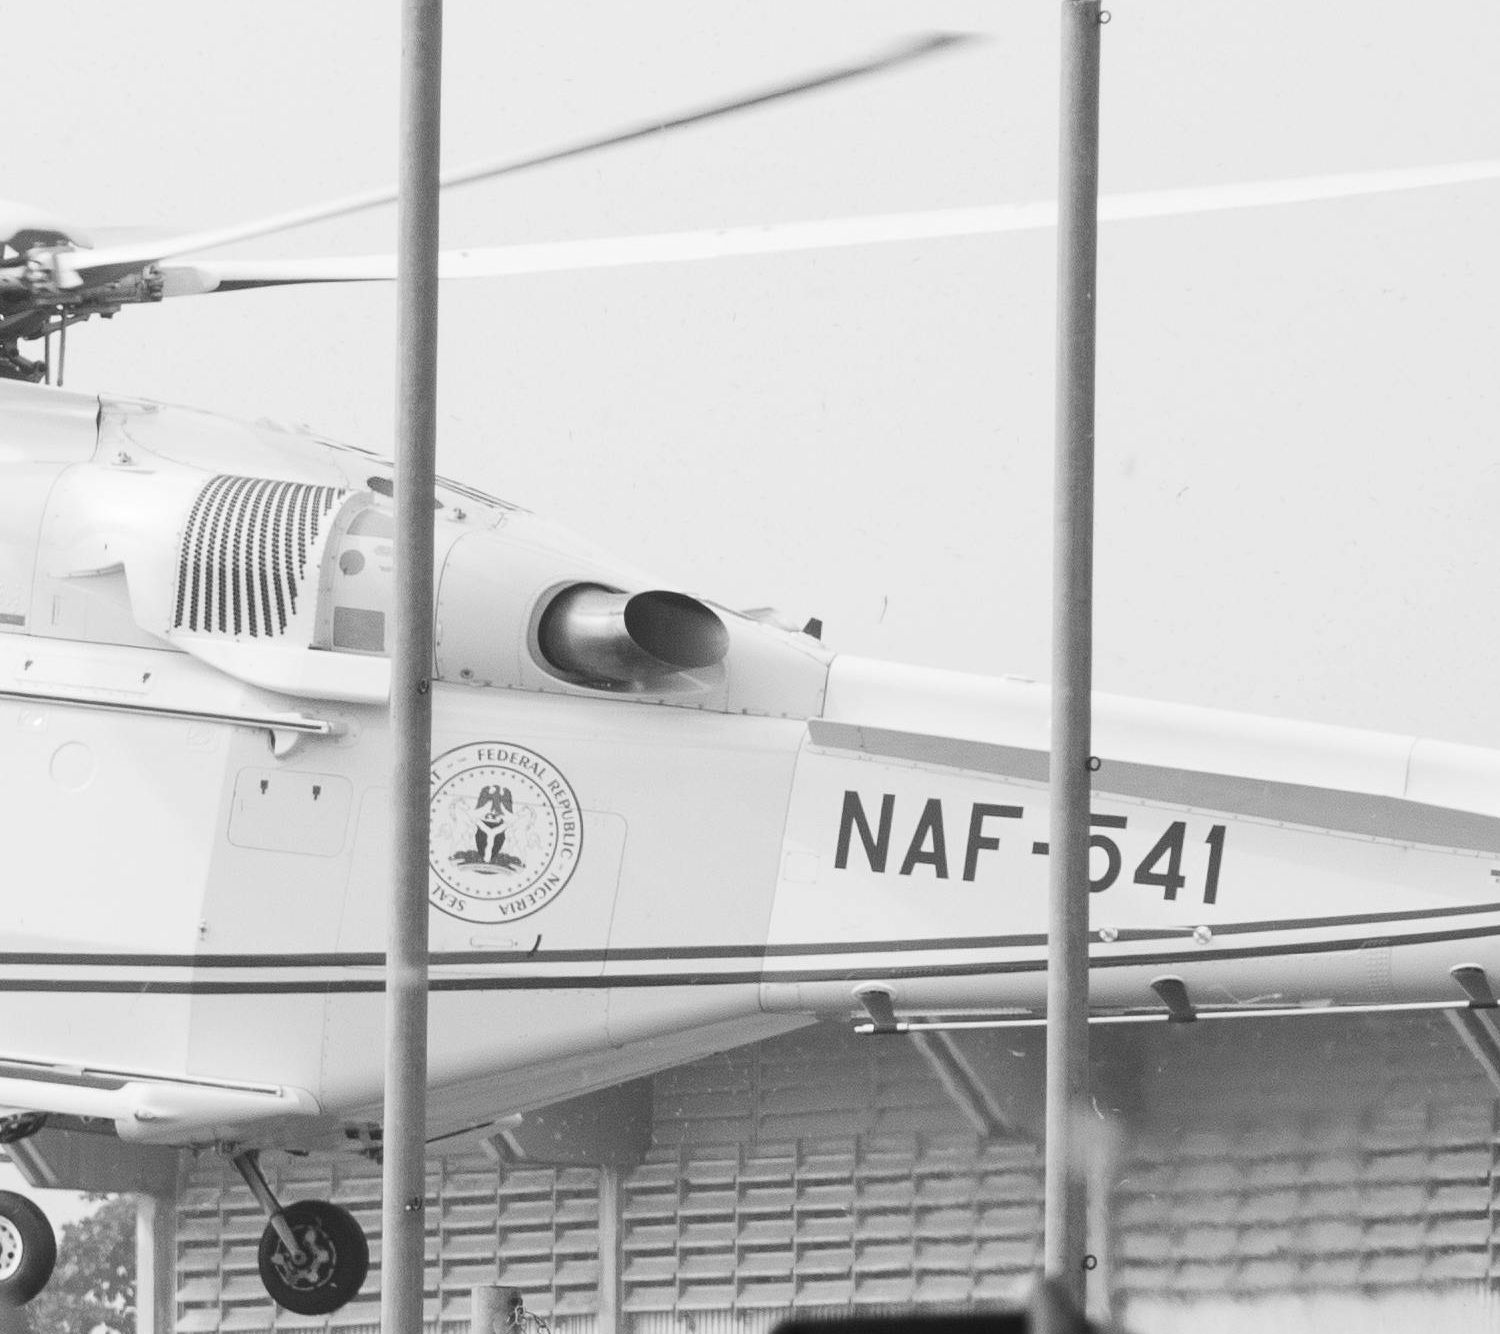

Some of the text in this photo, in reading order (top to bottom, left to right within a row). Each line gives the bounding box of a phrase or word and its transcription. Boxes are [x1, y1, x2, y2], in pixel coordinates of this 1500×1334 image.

[477, 748, 576, 916] FEDERAL REPUBLIC NIGERIA
[834, 790, 1226, 905] NAF-541
[431, 883, 466, 911] SEAL
